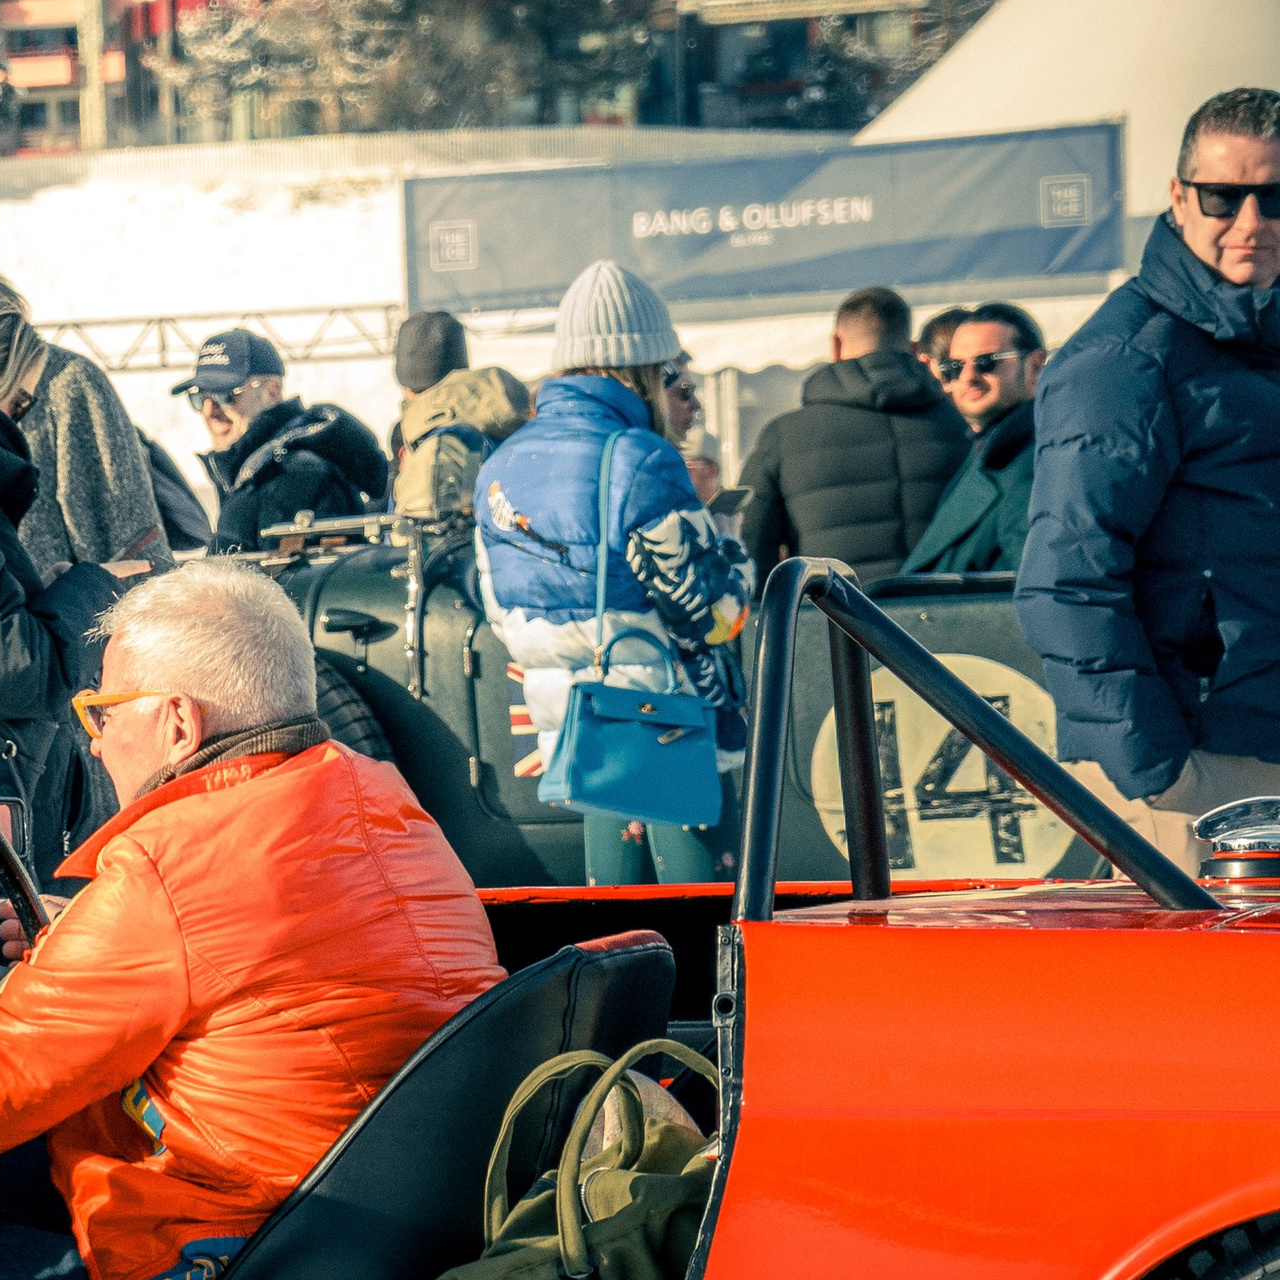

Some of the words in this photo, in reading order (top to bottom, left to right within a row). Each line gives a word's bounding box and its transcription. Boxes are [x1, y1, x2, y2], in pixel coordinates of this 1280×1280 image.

[632, 206, 713, 238] BANG
[719, 204, 738, 232] &
[742, 195, 873, 231] OLUFSEN
[873, 694, 1037, 870] 14
